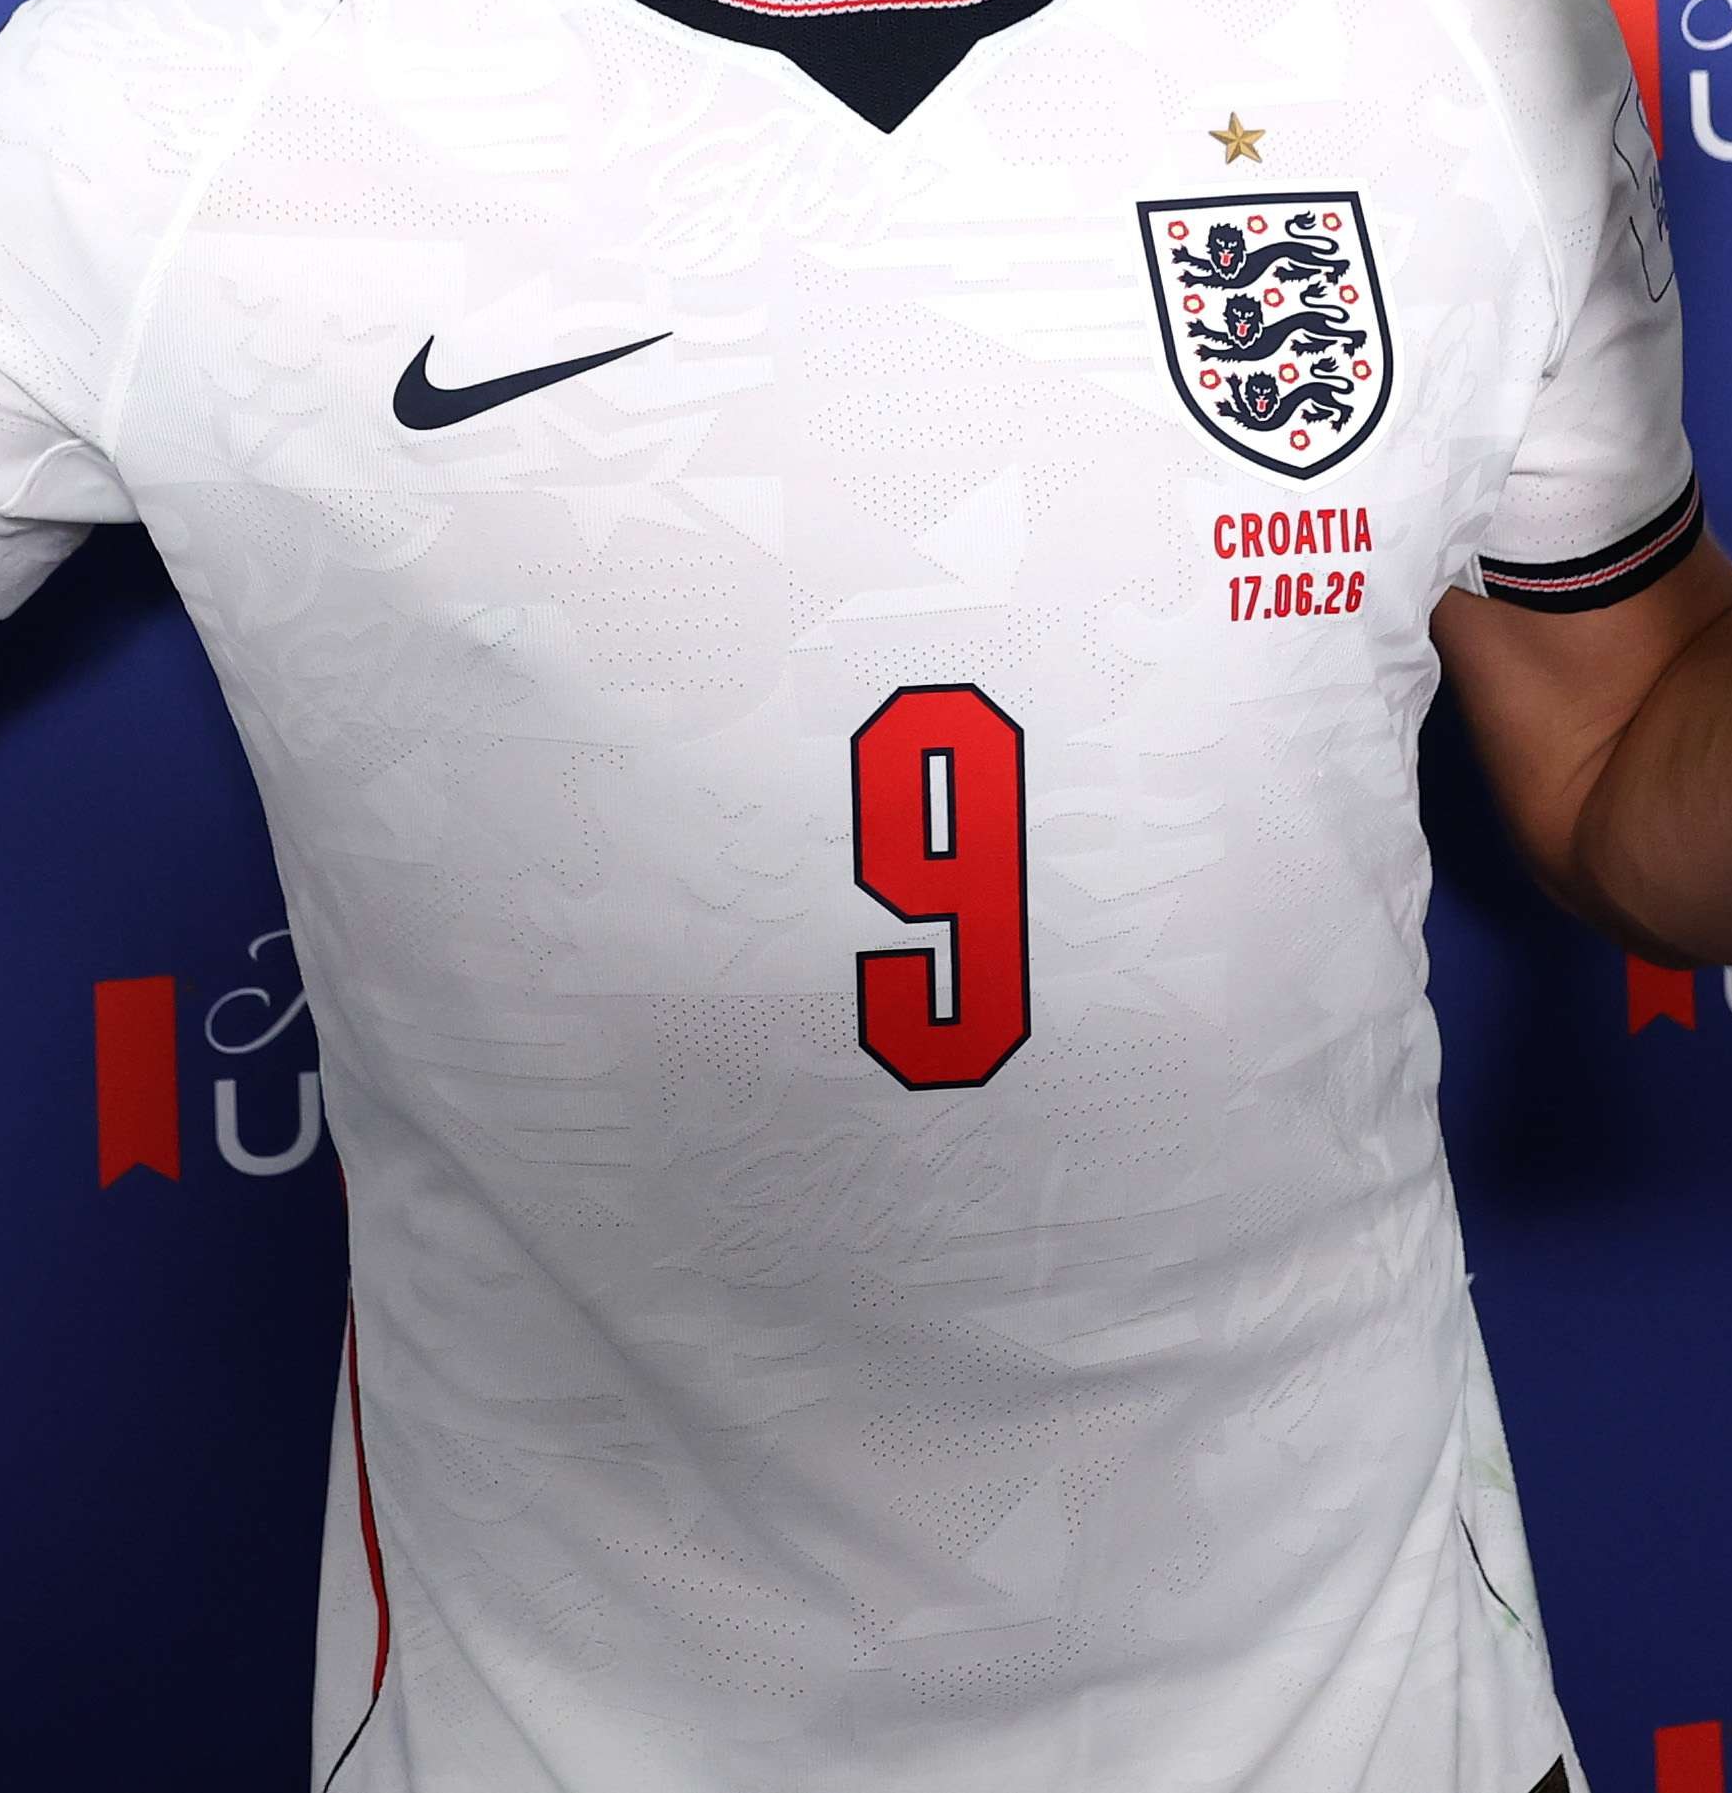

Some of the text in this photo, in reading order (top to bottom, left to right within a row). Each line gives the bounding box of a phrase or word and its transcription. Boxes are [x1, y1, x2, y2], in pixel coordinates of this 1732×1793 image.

[1214, 507, 1372, 559] CROATIA
[1229, 571, 1365, 622] 17.06.26
[851, 683, 1031, 1091] 9
